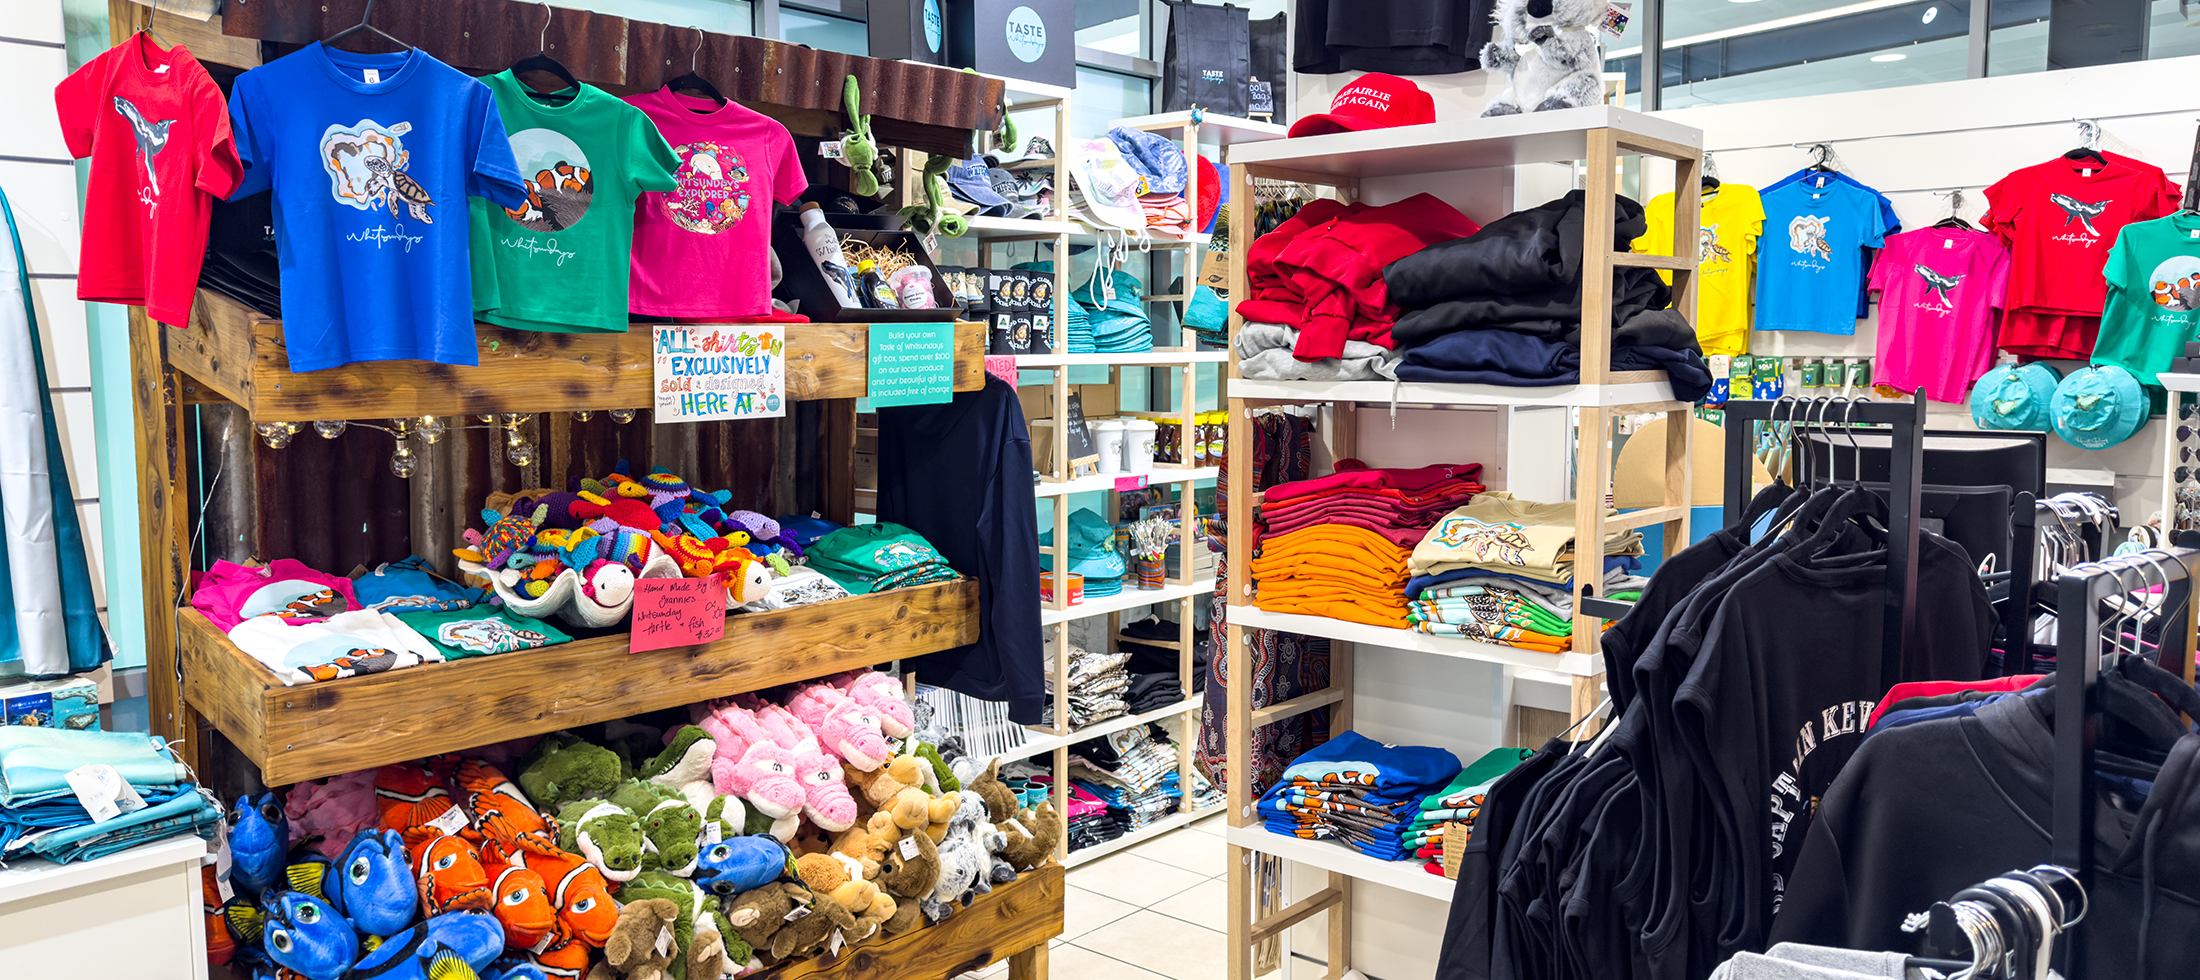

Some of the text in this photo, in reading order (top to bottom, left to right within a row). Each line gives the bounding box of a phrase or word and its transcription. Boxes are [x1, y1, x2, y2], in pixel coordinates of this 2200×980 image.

[924, 8, 940, 28] TASTE
[1008, 21, 1043, 38] TASTE
[1202, 69, 1224, 78] TASTE
[1249, 83, 1265, 93] OOL
[1352, 86, 1392, 102] AIRLIE
[1349, 95, 1390, 112] AGAIN
[679, 188, 730, 200] EXPLORER
[346, 223, 424, 254] Whitsundays
[501, 236, 576, 267] Whitsundays
[657, 329, 761, 357] ALL shirts
[888, 331, 937, 341] Build your own
[879, 343, 896, 351] Taste
[896, 341, 904, 353] of
[671, 354, 772, 377] EXCLUSIVELY
[872, 353, 882, 364] gift
[898, 353, 919, 363] spend
[919, 353, 934, 361] over
[934, 352, 951, 361] $100
[877, 364, 945, 375] on our local produce
[660, 376, 693, 393] sold
[704, 374, 767, 400] designed
[871, 374, 951, 387] and our beautiful gift box
[871, 385, 951, 398] is included free of charge
[680, 391, 730, 416] HERE
[733, 392, 757, 416] AT
[644, 583, 665, 594] Hand
[669, 582, 691, 592] Made
[695, 581, 708, 595] by
[688, 616, 706, 633] fish
